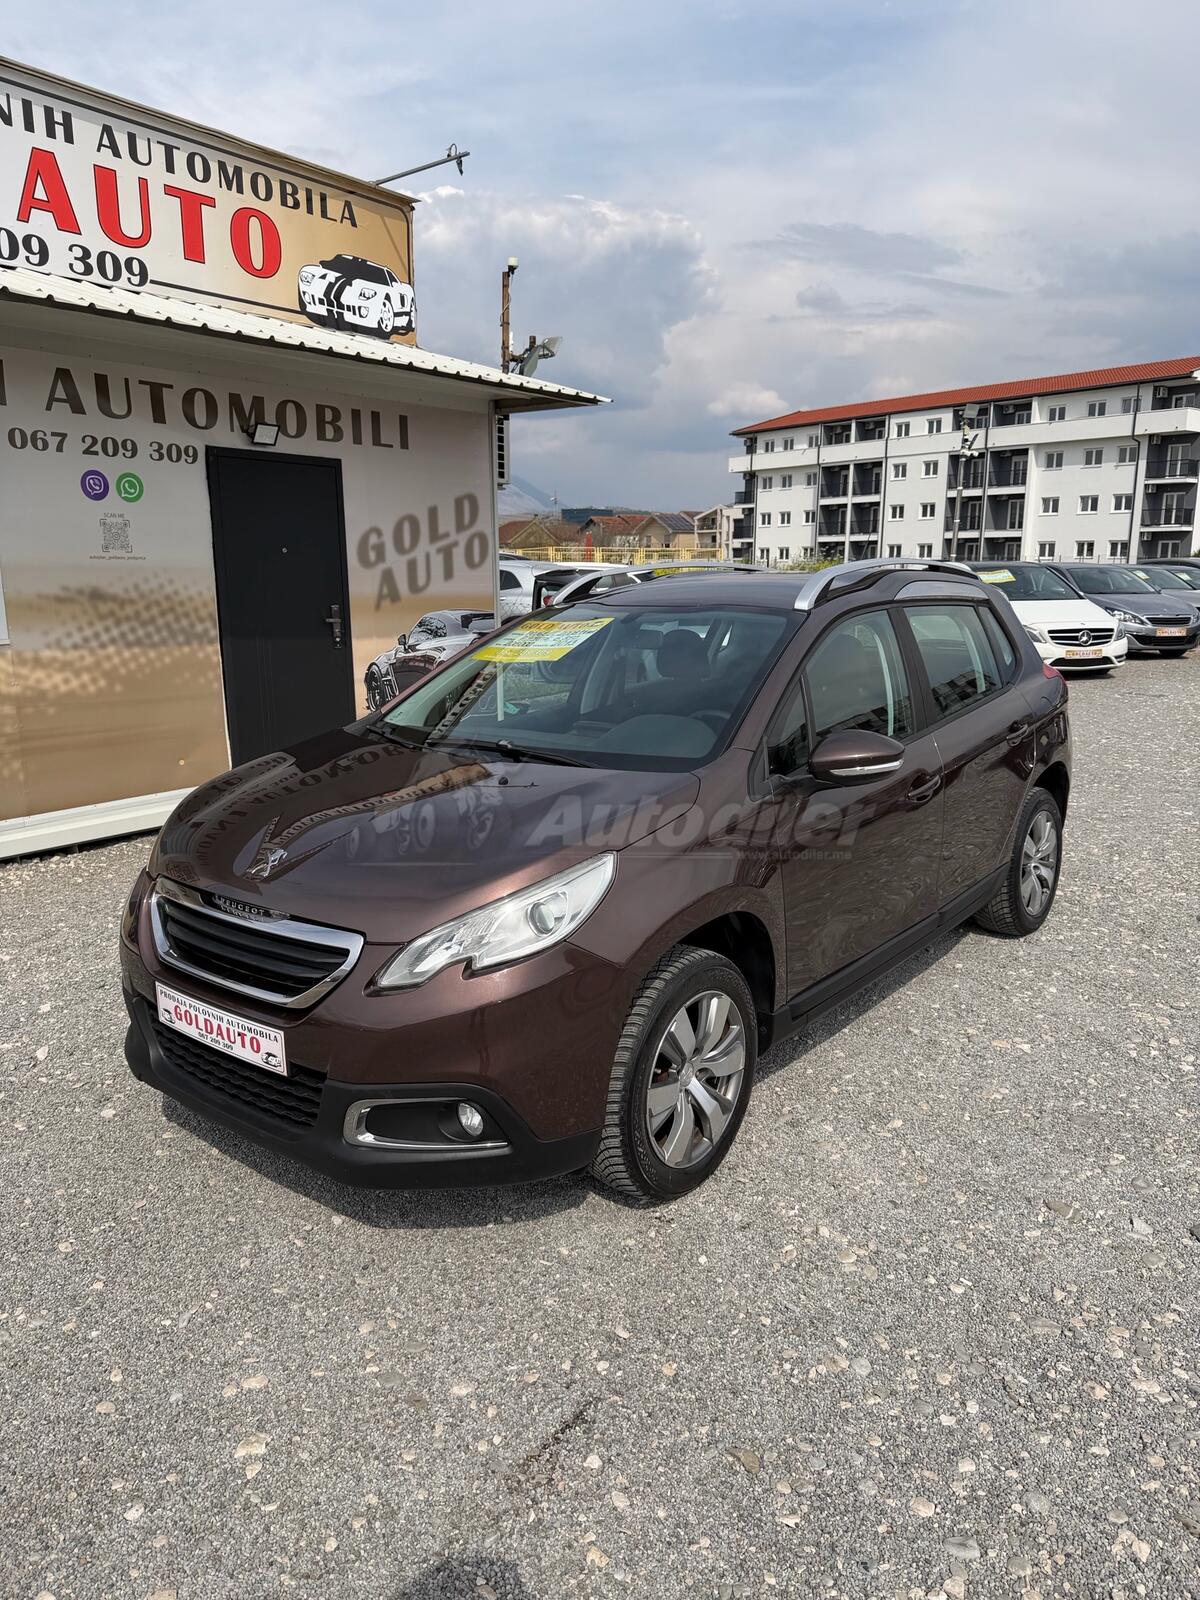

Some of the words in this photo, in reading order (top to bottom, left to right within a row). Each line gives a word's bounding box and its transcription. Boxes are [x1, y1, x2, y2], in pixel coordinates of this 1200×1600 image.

[16, 146, 282, 279] AUTO
[96, 123, 358, 229] AUTOMOBILA
[68, 243, 149, 287] 309
[7, 426, 68, 453] 067
[81, 433, 138, 459] 209
[149, 440, 199, 465] 309
[45, 366, 409, 450] AUTOMOBILI
[356, 491, 480, 571] GOLD
[373, 528, 490, 613] AUTO
[159, 989, 189, 1009] PRODAJA
[188, 1002, 225, 1024] POLOVNIH
[226, 1018, 279, 1043] AUTOMOBILA
[173, 1004, 261, 1054] GOLDAUTO
